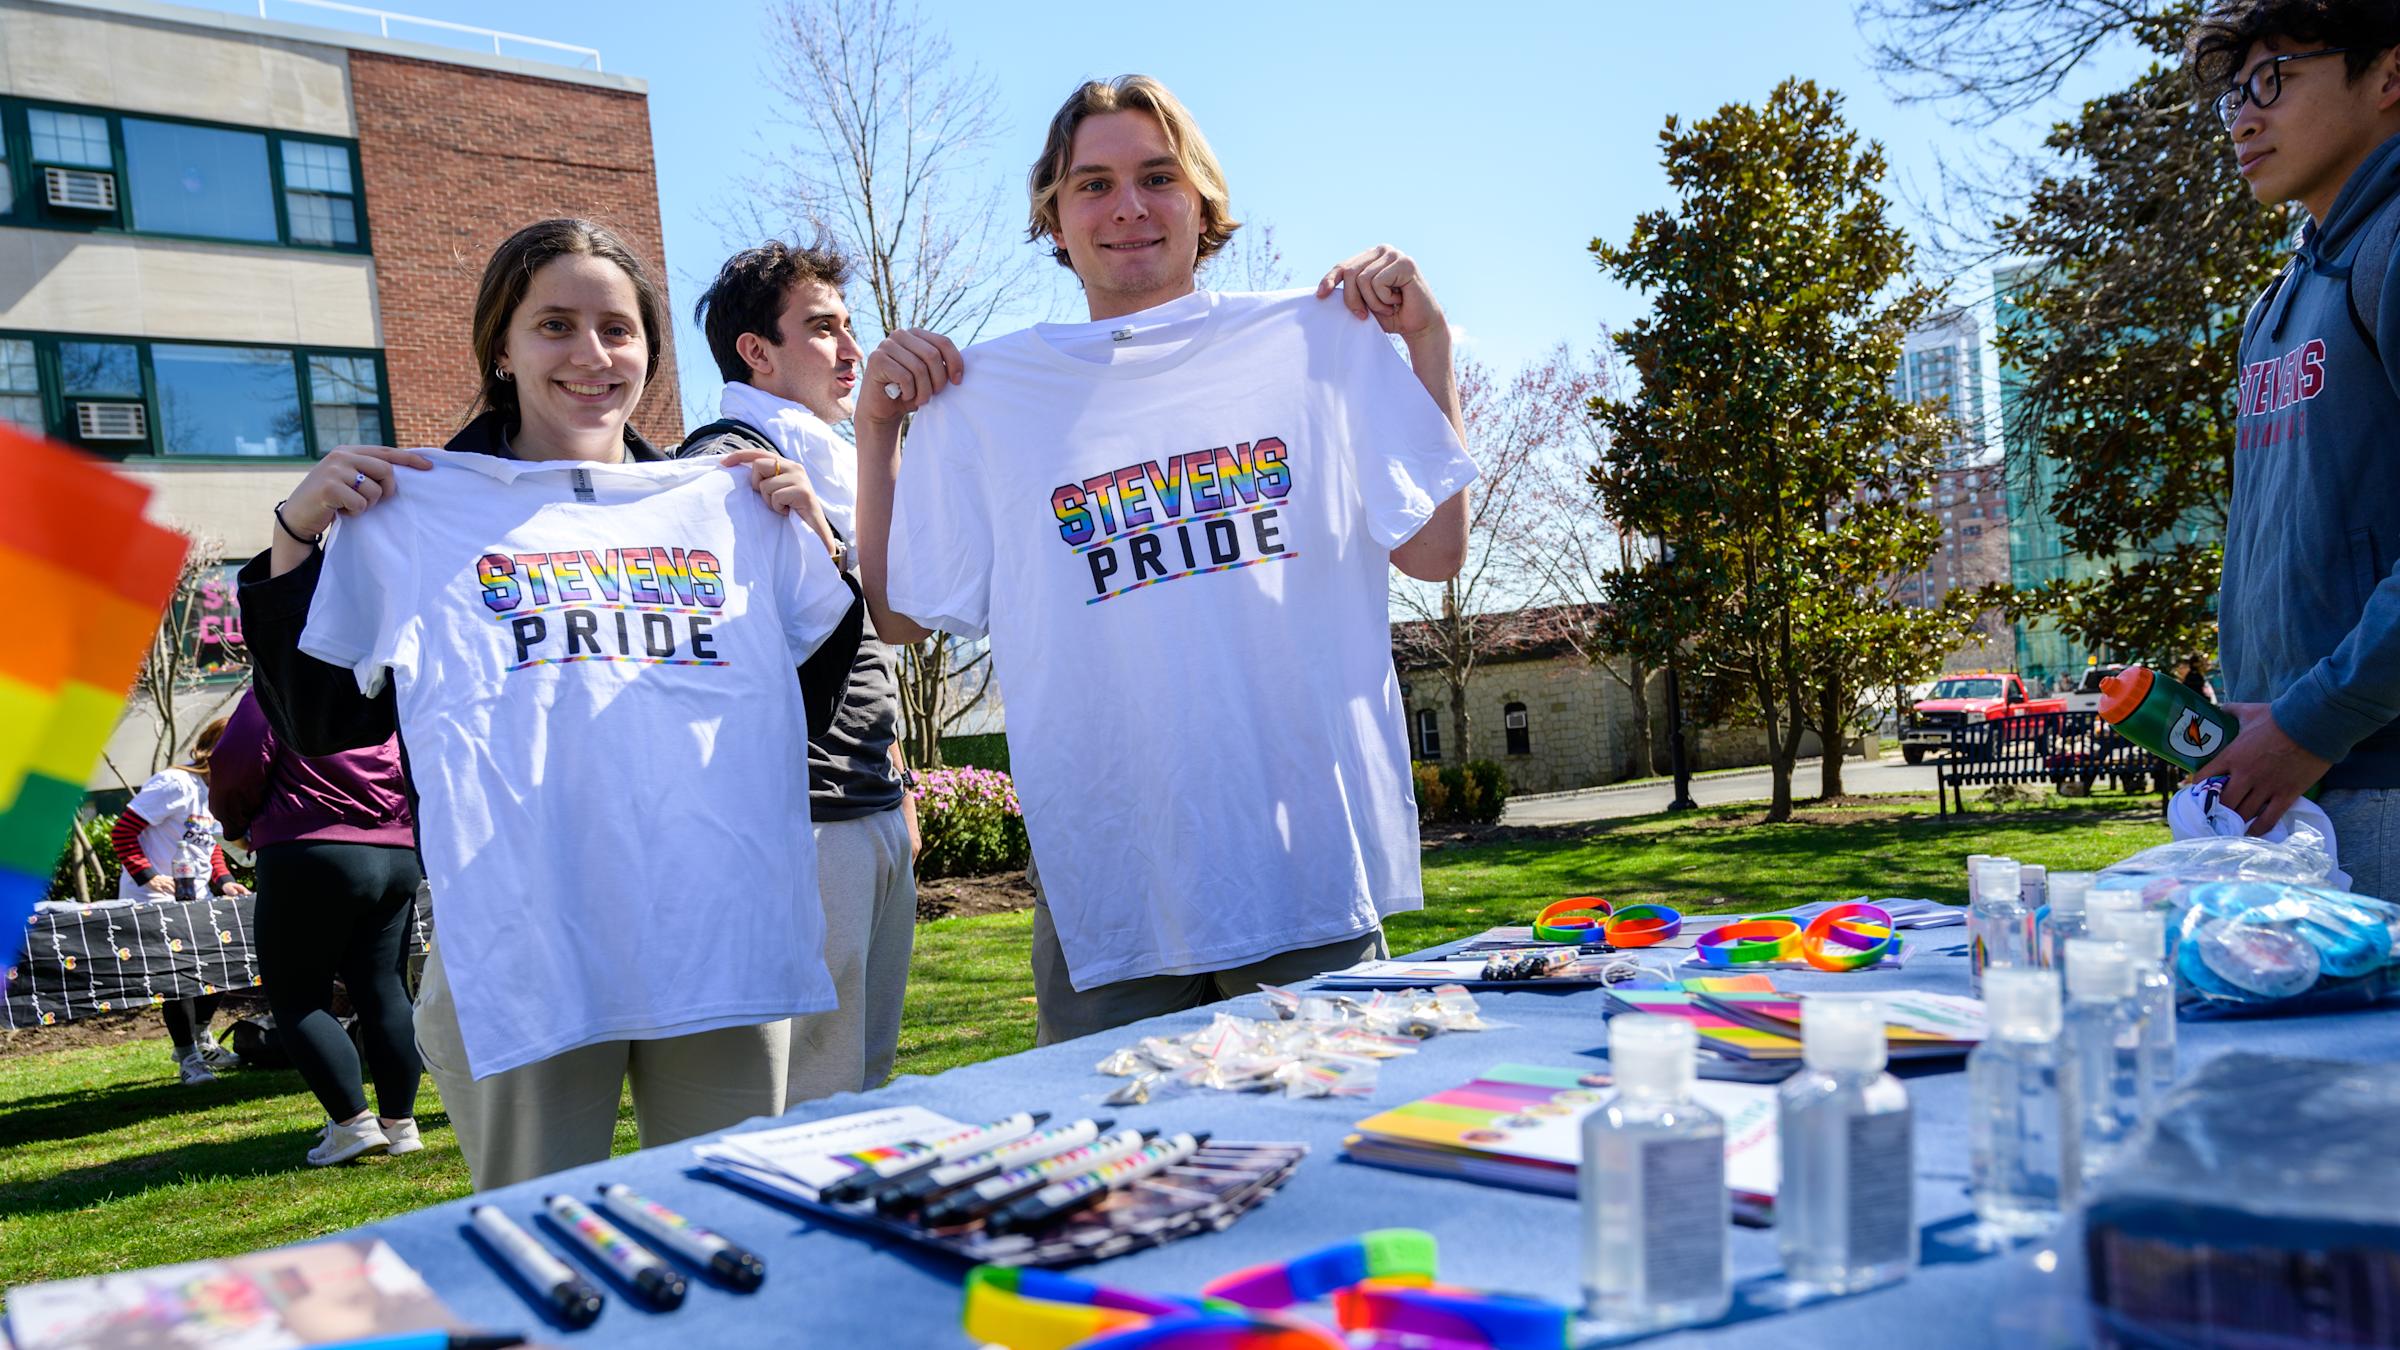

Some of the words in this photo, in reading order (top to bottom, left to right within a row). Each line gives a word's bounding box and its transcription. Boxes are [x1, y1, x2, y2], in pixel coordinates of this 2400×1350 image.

[1050, 436, 1292, 546] STEVENS
[476, 547, 725, 612] STEVENS
[1086, 509, 1285, 594] PRIDE
[512, 609, 718, 662] PRIDE
